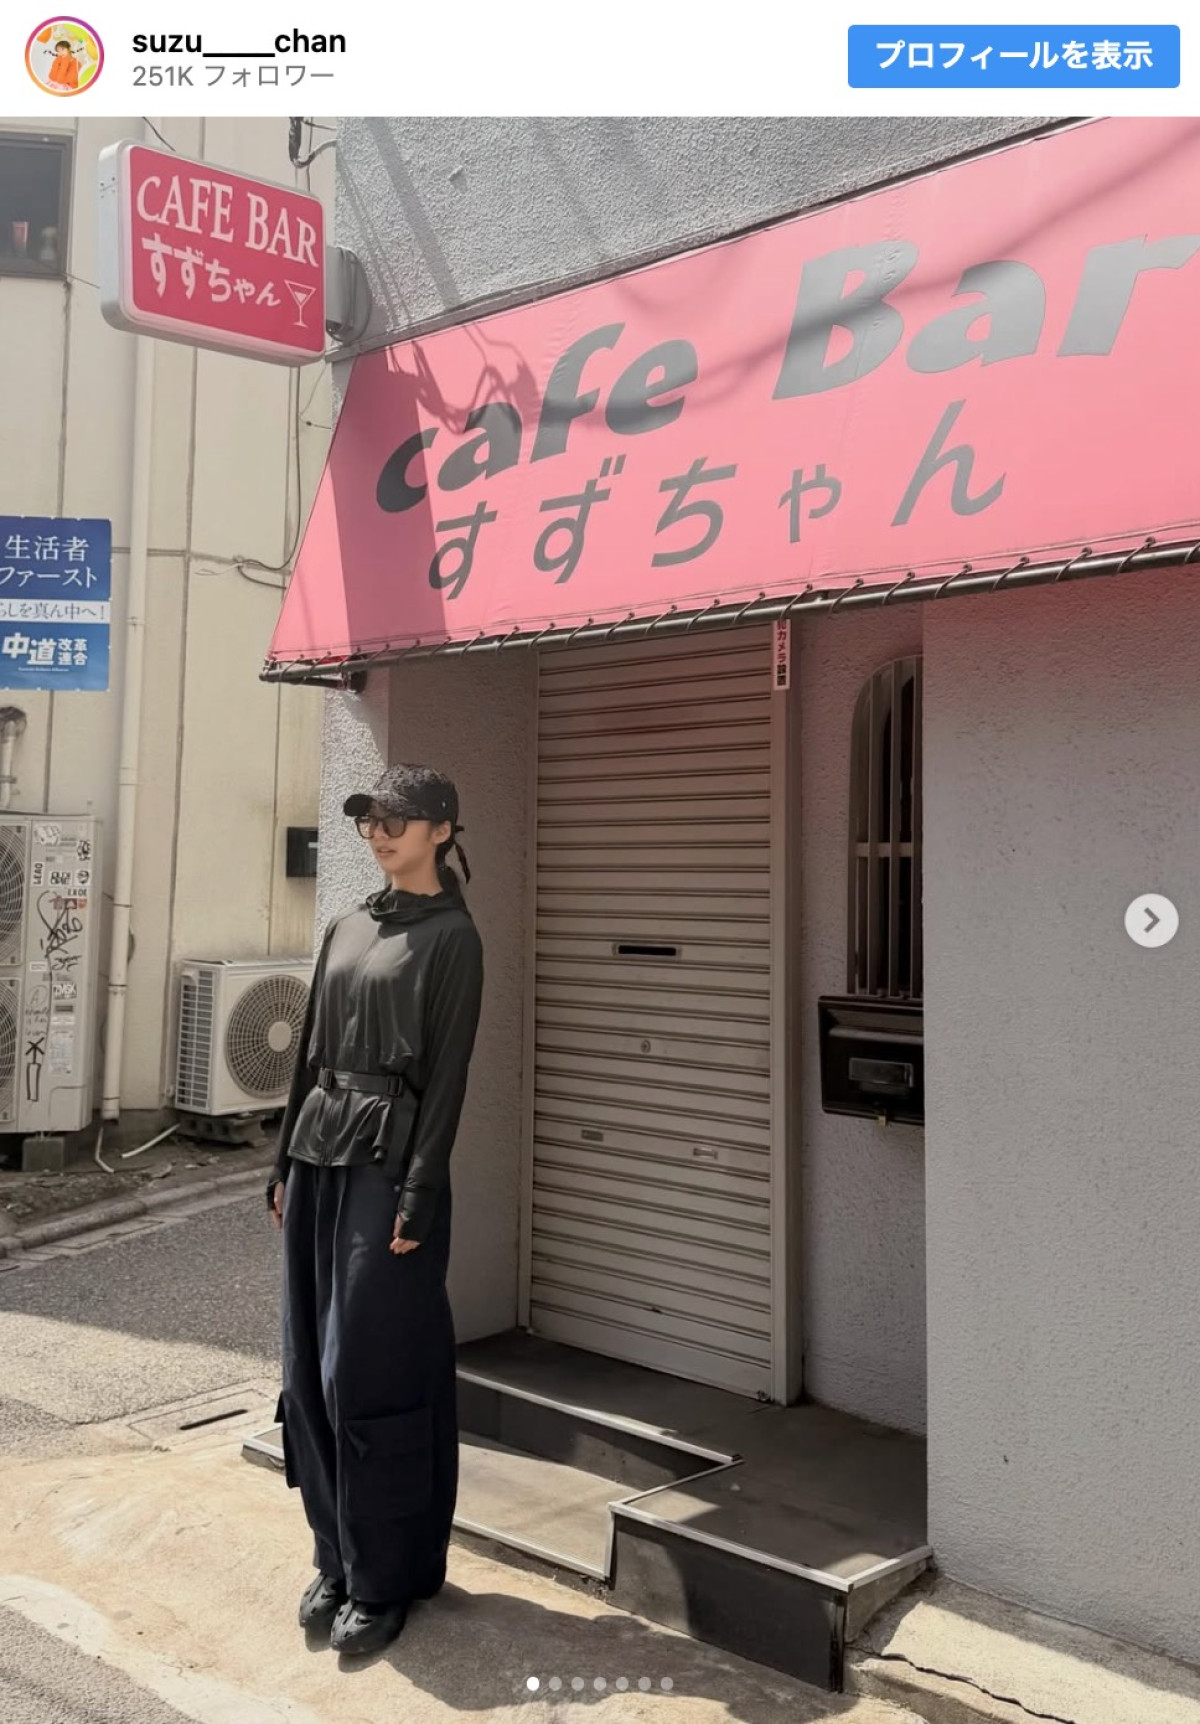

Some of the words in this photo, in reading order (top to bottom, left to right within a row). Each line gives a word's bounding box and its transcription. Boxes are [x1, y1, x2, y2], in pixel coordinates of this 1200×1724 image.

[136, 174, 235, 243] CAFE
[246, 192, 320, 268] BAR
[141, 234, 281, 307] すずちゃん
[772, 234, 1200, 401] Bar
[428, 399, 1007, 601] すずちゃん
[0, 565, 98, 589] ファースト
[4, 533, 90, 562] 生活者
[2, 632, 57, 665] 中道
